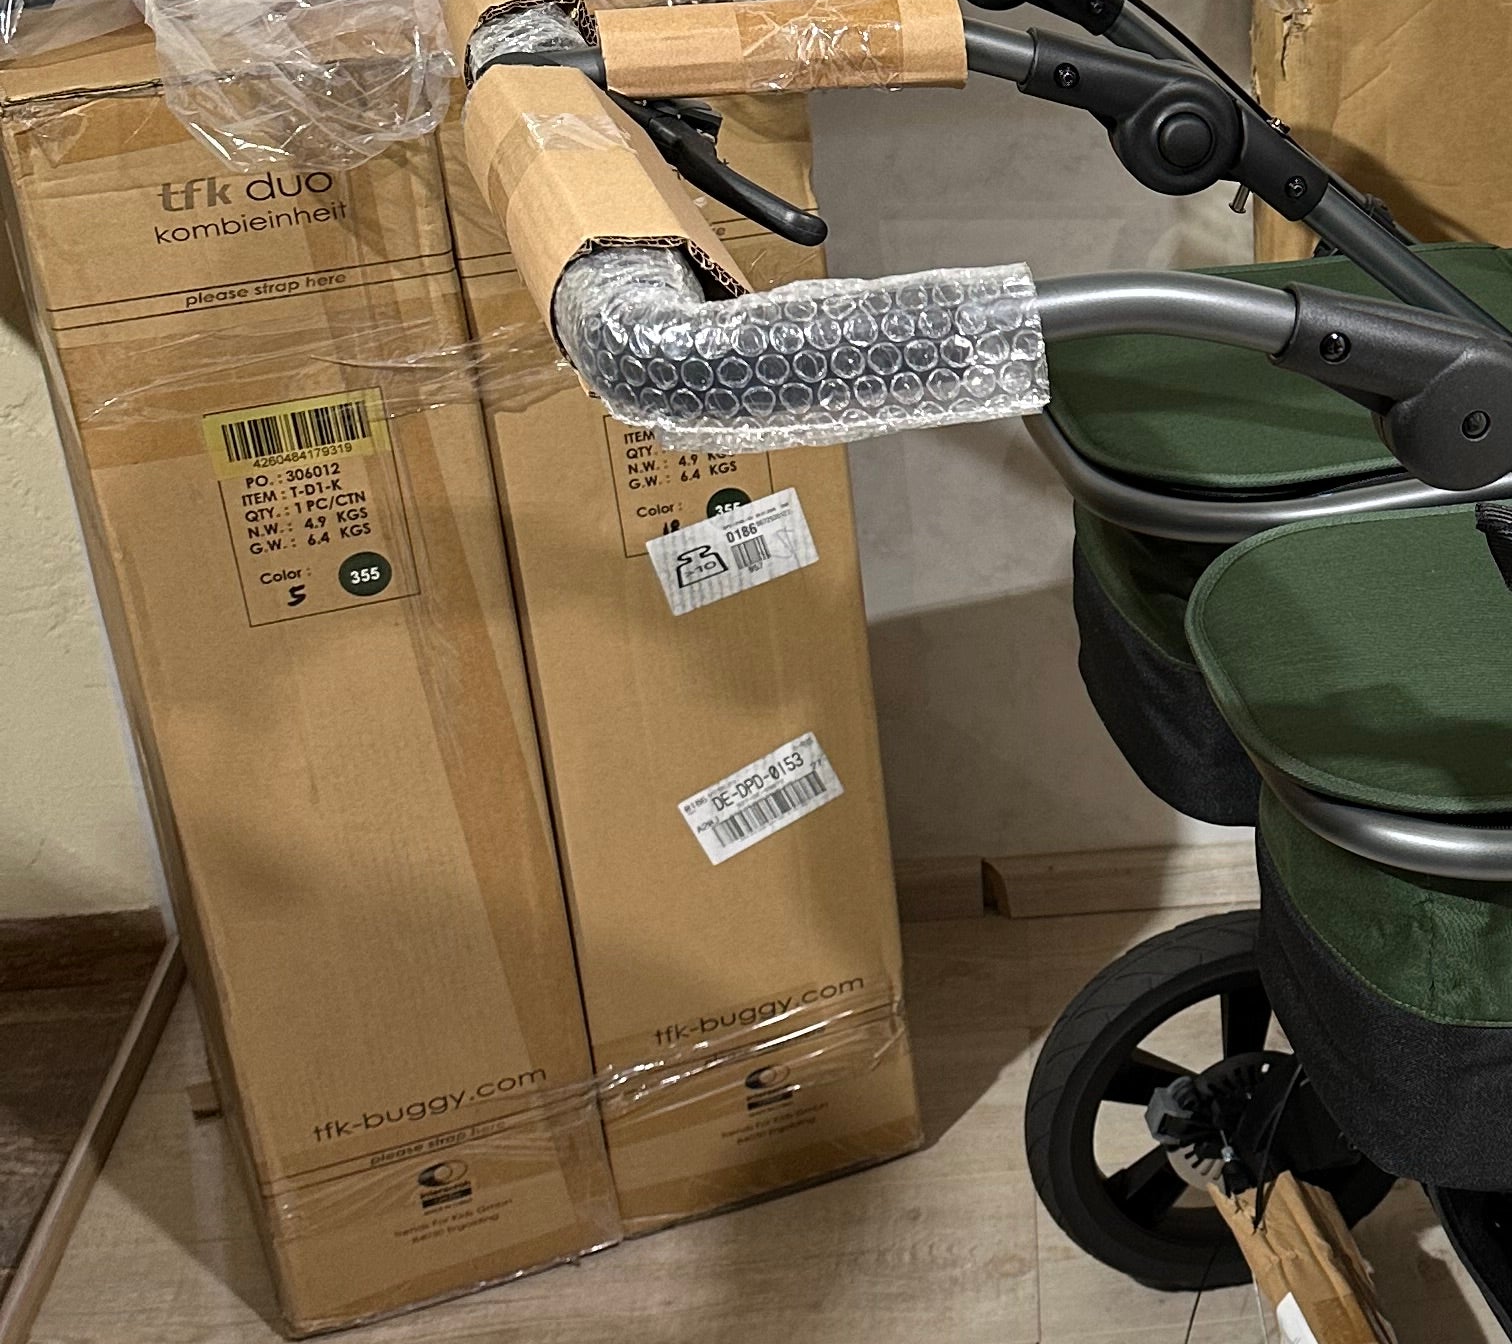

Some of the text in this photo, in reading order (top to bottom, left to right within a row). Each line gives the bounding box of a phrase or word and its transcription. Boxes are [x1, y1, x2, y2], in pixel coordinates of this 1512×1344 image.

[157, 171, 333, 212] tfk duo
[154, 202, 348, 244] kombieinheit
[185, 271, 347, 309] please strap here
[678, 454, 698, 467] 4.9
[680, 469, 701, 483] 6.4
[709, 460, 738, 476] KGS
[285, 462, 341, 483] 306012
[241, 490, 278, 507] ITEM
[290, 478, 343, 499] T-D1-K
[307, 491, 366, 513] PC/CTN
[304, 515, 326, 530] 4.9
[336, 507, 369, 524] KGS
[636, 503, 674, 518] Color
[307, 531, 331, 546] 6.4
[340, 523, 372, 539] KGS
[725, 522, 758, 544] 0186
[259, 568, 303, 585] Color
[350, 566, 381, 585] 355
[654, 976, 865, 1046] tfk-buggy.com
[312, 1067, 547, 1142] tfk-buggy.com
